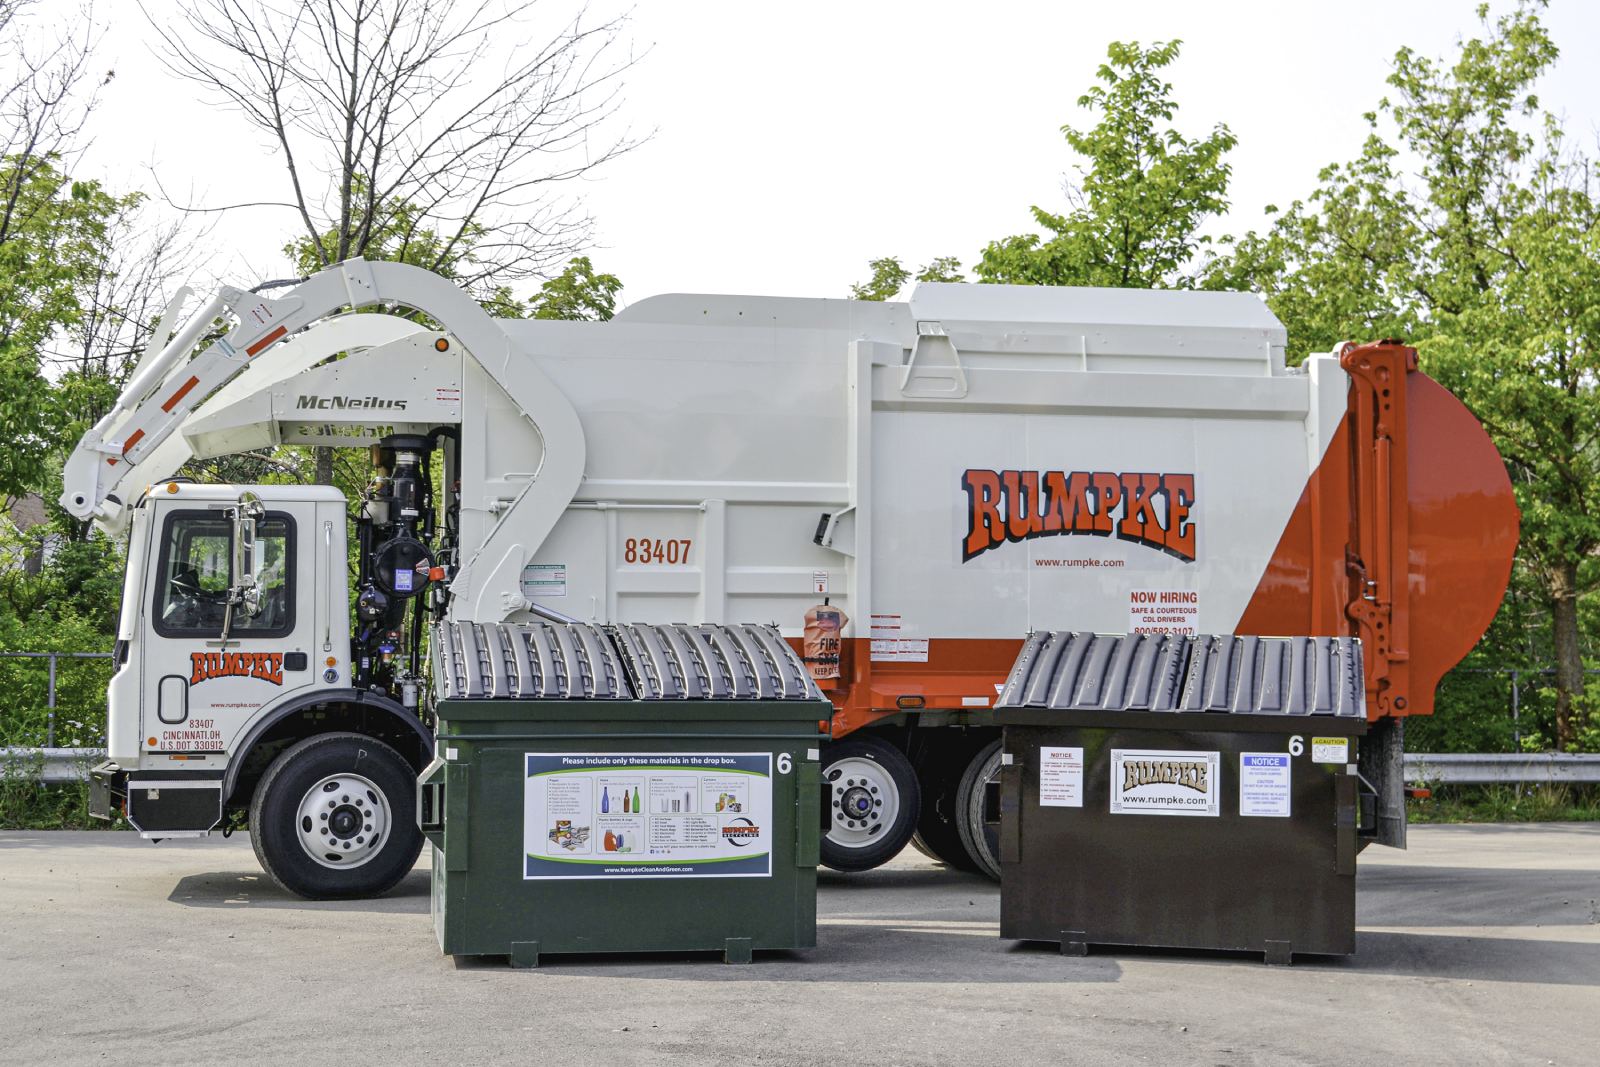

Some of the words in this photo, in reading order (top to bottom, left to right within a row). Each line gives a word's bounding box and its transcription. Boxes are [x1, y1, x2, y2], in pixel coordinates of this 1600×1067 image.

[297, 395, 407, 411] McNeilus
[962, 469, 1196, 564] RUMPKE
[624, 538, 692, 564] 83407
[1036, 557, 1124, 569] www.rumpke.com
[1131, 592, 1157, 603] NOW
[1160, 592, 1197, 603] HIRING
[819, 638, 840, 652] FIRE
[190, 652, 283, 687] RUMPKE
[210, 702, 262, 710] www.rumpke.com
[189, 719, 214, 729] 83407
[194, 740, 224, 750] 330912
[1288, 735, 1304, 757] 6
[562, 757, 584, 765] Please
[585, 757, 611, 765] include
[612, 757, 627, 766] only
[629, 757, 648, 765] these
[703, 757, 719, 766] drop
[777, 752, 792, 775] 6
[1251, 758, 1280, 766] NOTICE
[1123, 760, 1207, 794] RUMPKE
[1123, 796, 1207, 806] www.rumpke.com
